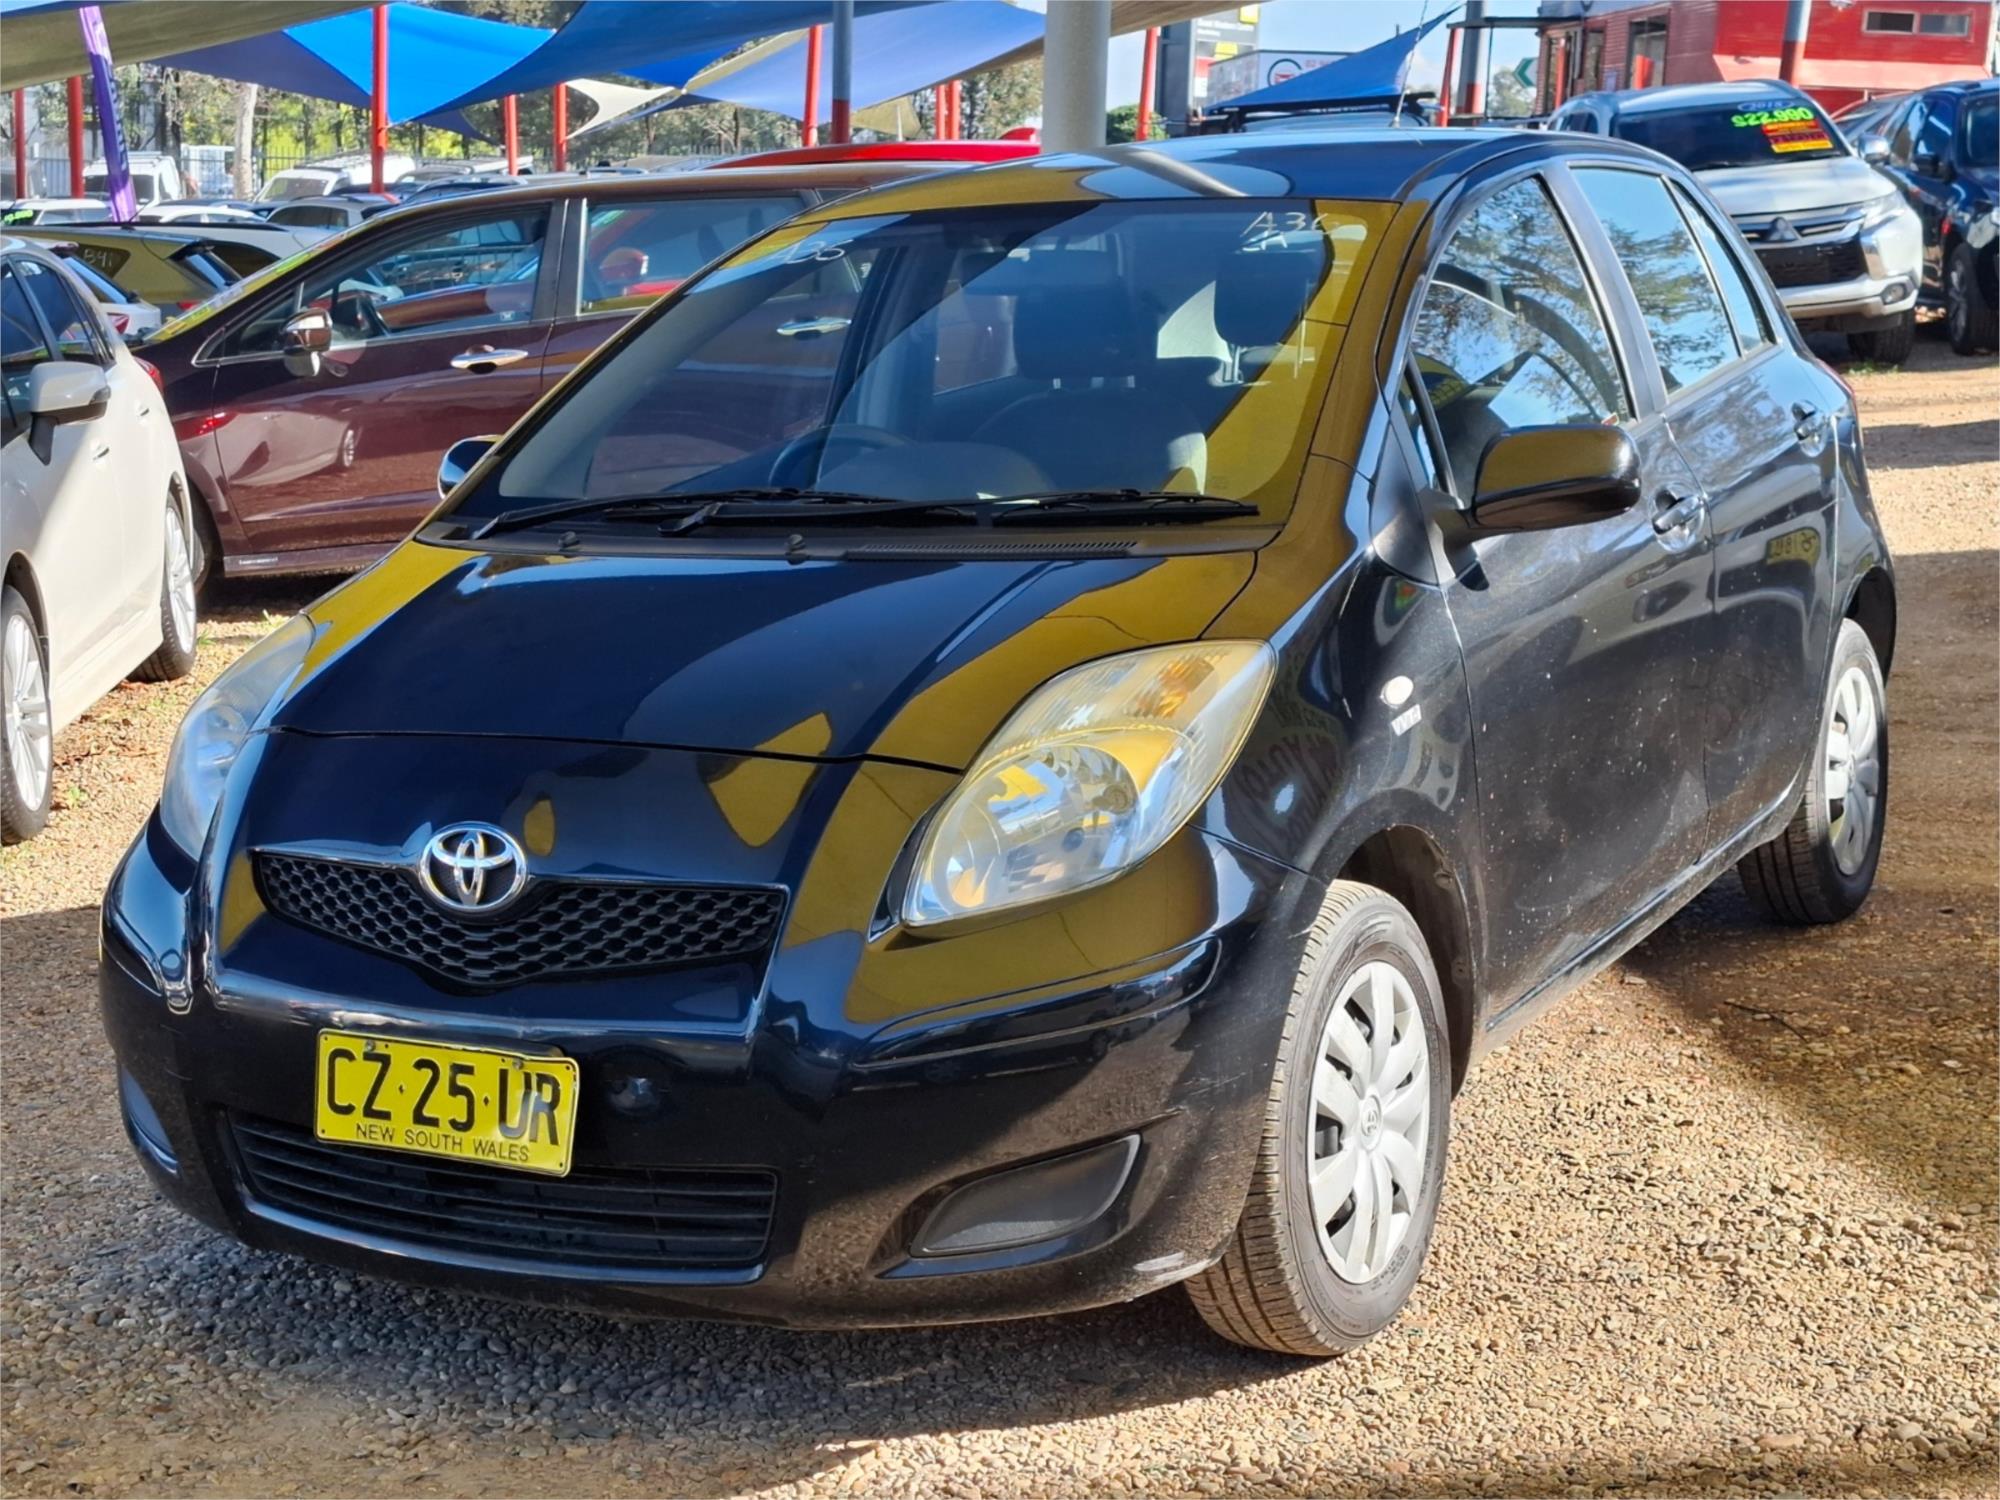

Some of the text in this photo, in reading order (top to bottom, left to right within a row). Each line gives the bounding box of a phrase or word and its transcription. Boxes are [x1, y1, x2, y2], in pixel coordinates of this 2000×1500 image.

[356, 1123, 530, 1163] NEW SOUTH WALES
